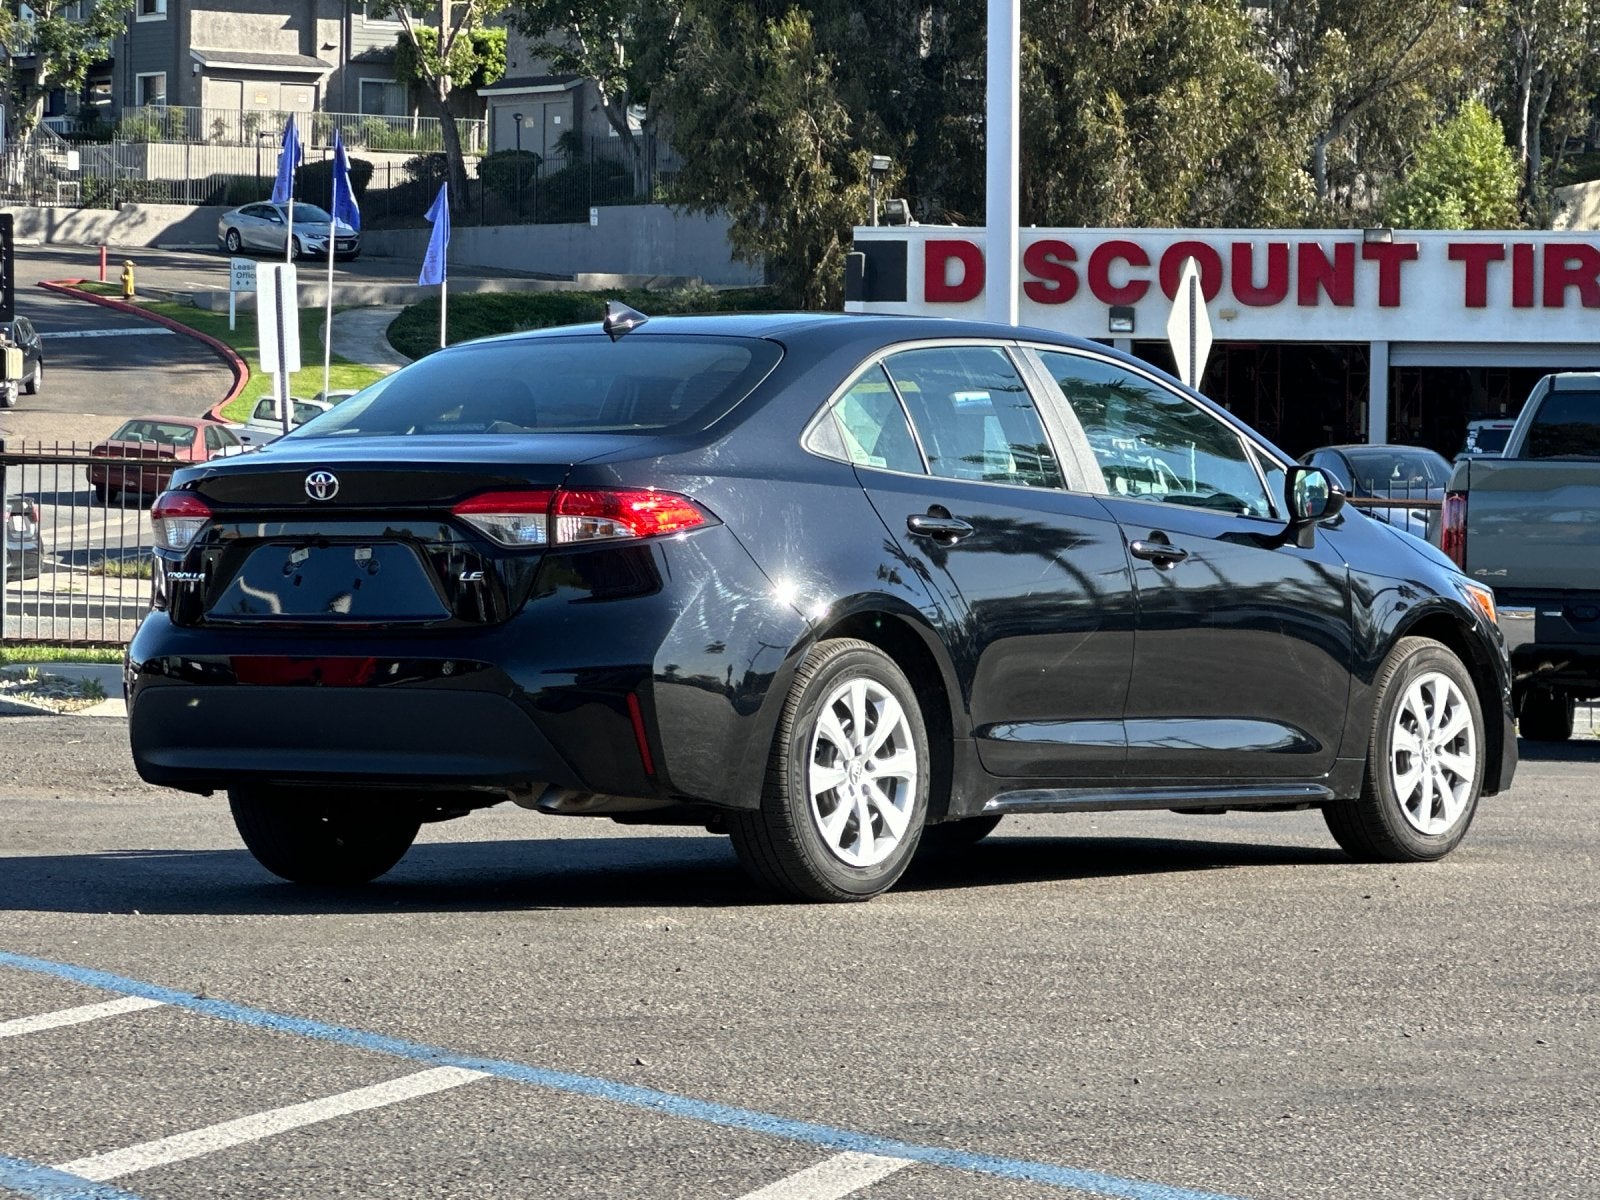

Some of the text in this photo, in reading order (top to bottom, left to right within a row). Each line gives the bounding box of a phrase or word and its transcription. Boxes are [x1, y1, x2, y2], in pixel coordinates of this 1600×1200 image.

[236, 271, 256, 279] Offic
[924, 239, 1419, 307] DSCOUNT
[459, 571, 485, 581] LE
